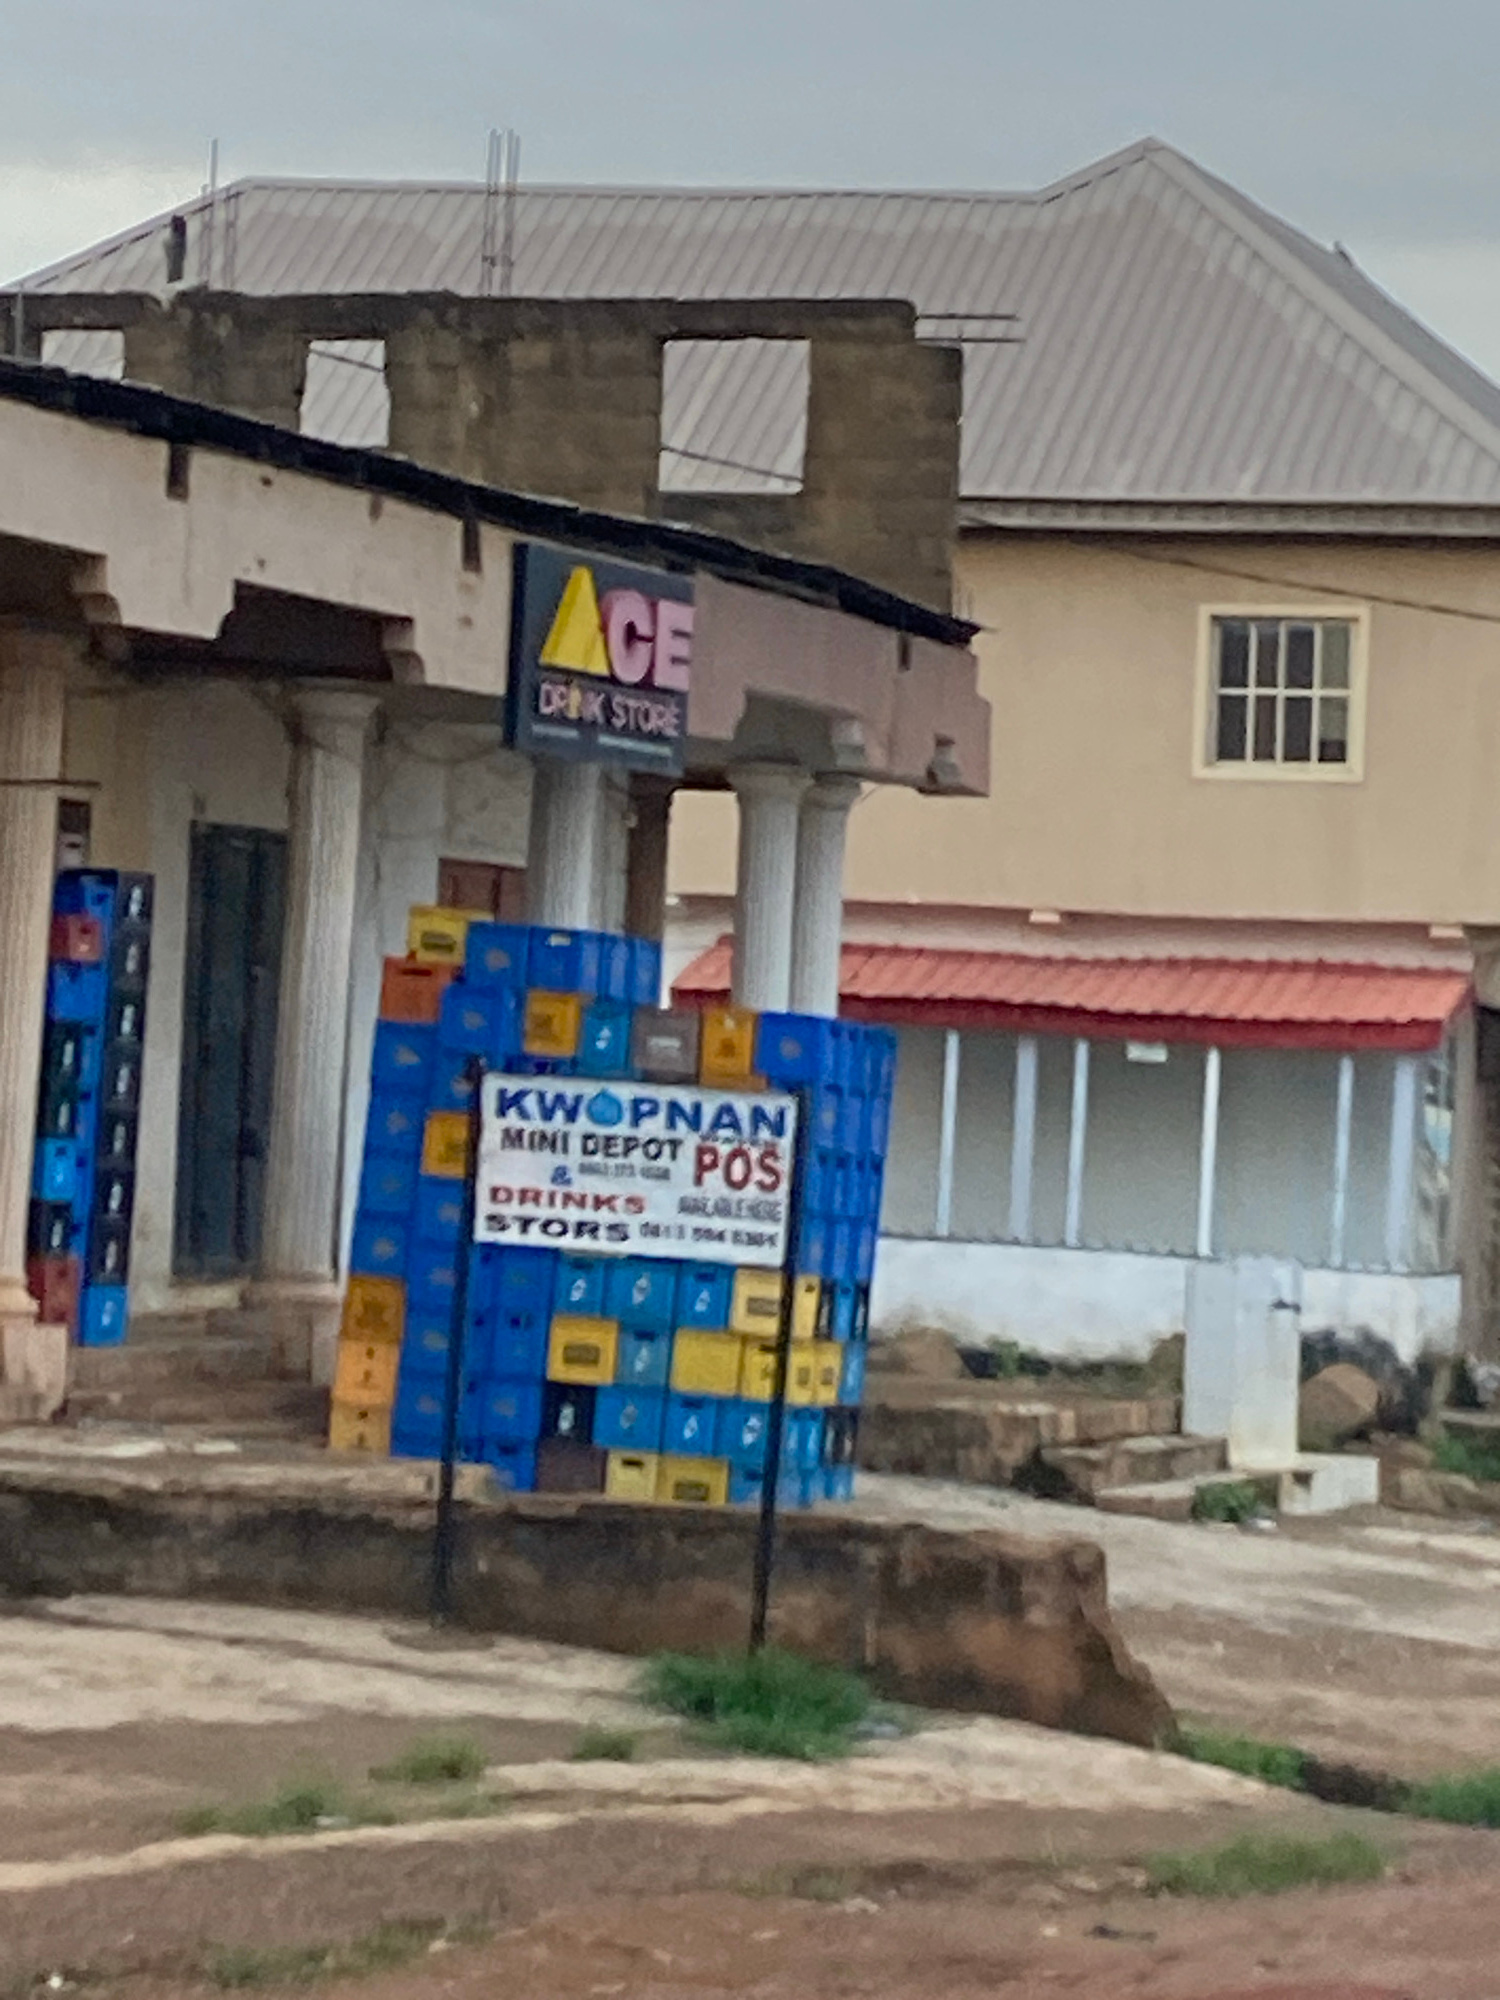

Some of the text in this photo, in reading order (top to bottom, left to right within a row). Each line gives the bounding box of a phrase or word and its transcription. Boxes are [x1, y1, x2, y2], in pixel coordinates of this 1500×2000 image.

[538, 564, 696, 691] ACE
[610, 694, 680, 736] STORE
[501, 1127, 570, 1155] MINI
[580, 1132, 684, 1161] DEPOT
[550, 1165, 573, 1186] &
[693, 1142, 781, 1192] POS
[489, 1186, 648, 1214] DRINKS
[484, 1214, 630, 1242] STORS
